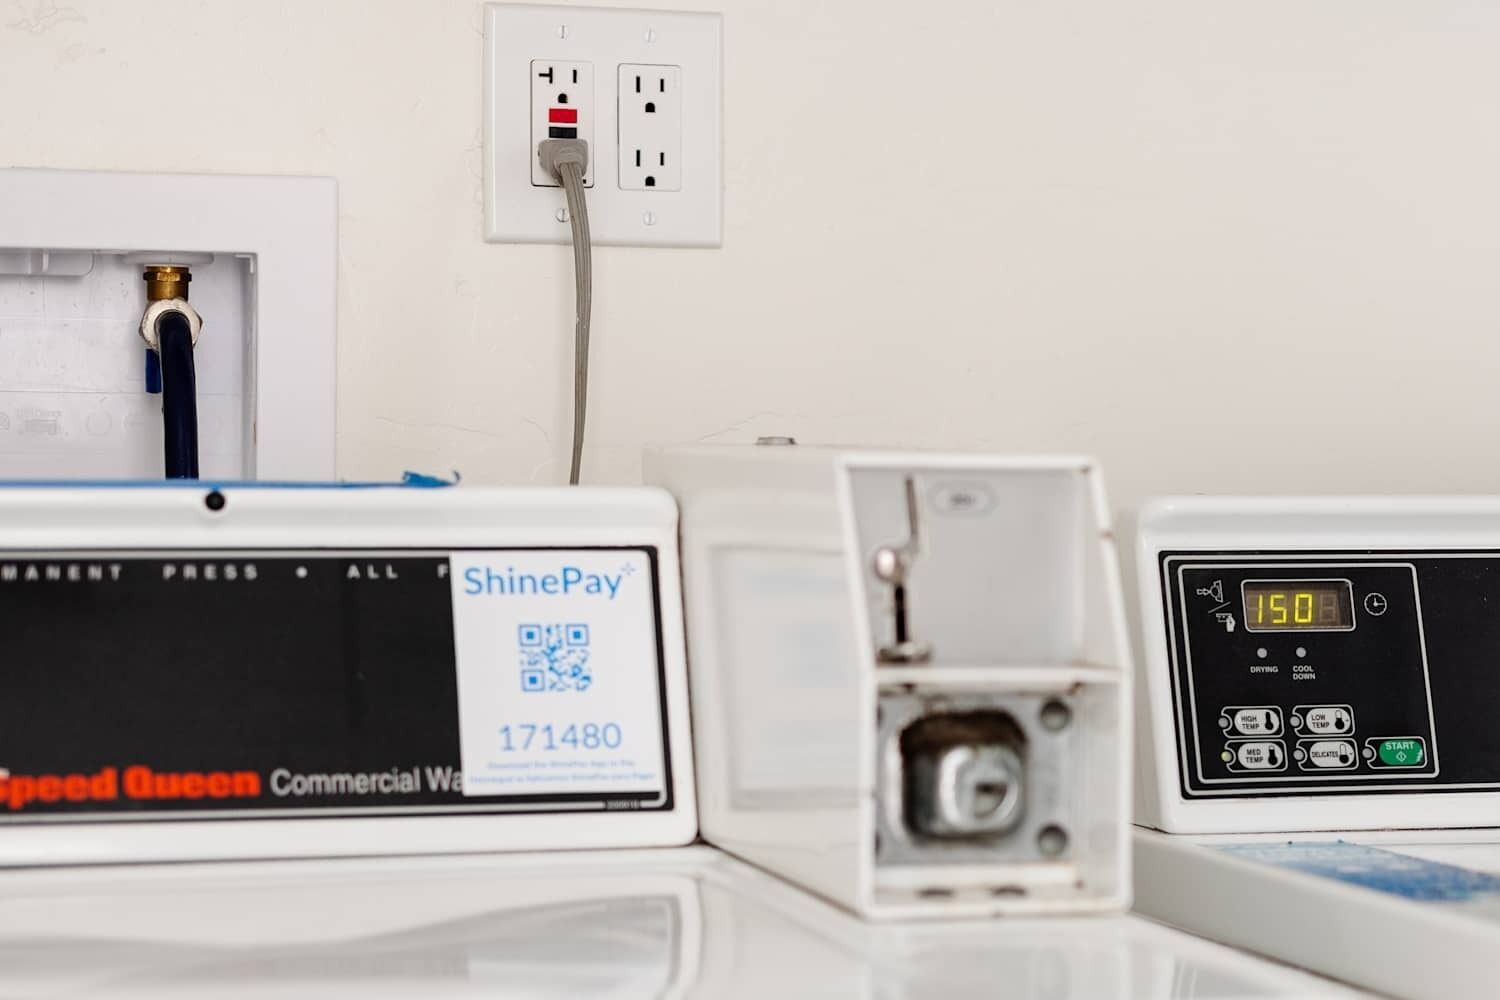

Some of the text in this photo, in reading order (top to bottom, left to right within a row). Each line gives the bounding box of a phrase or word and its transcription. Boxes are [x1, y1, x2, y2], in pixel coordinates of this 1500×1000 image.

[162, 564, 258, 581] PRESS
[346, 564, 399, 580] ALL
[463, 566, 622, 600] ShinePay
[1257, 593, 1313, 624] 150
[1250, 665, 1279, 674] DRYING
[1292, 665, 1314, 673] COOL
[1292, 673, 1316, 681] DOWN
[498, 721, 622, 752] 171480
[1246, 748, 1261, 756] MED
[1384, 741, 1415, 751] START
[122, 764, 262, 800] Queen
[269, 767, 421, 796] Commercial
